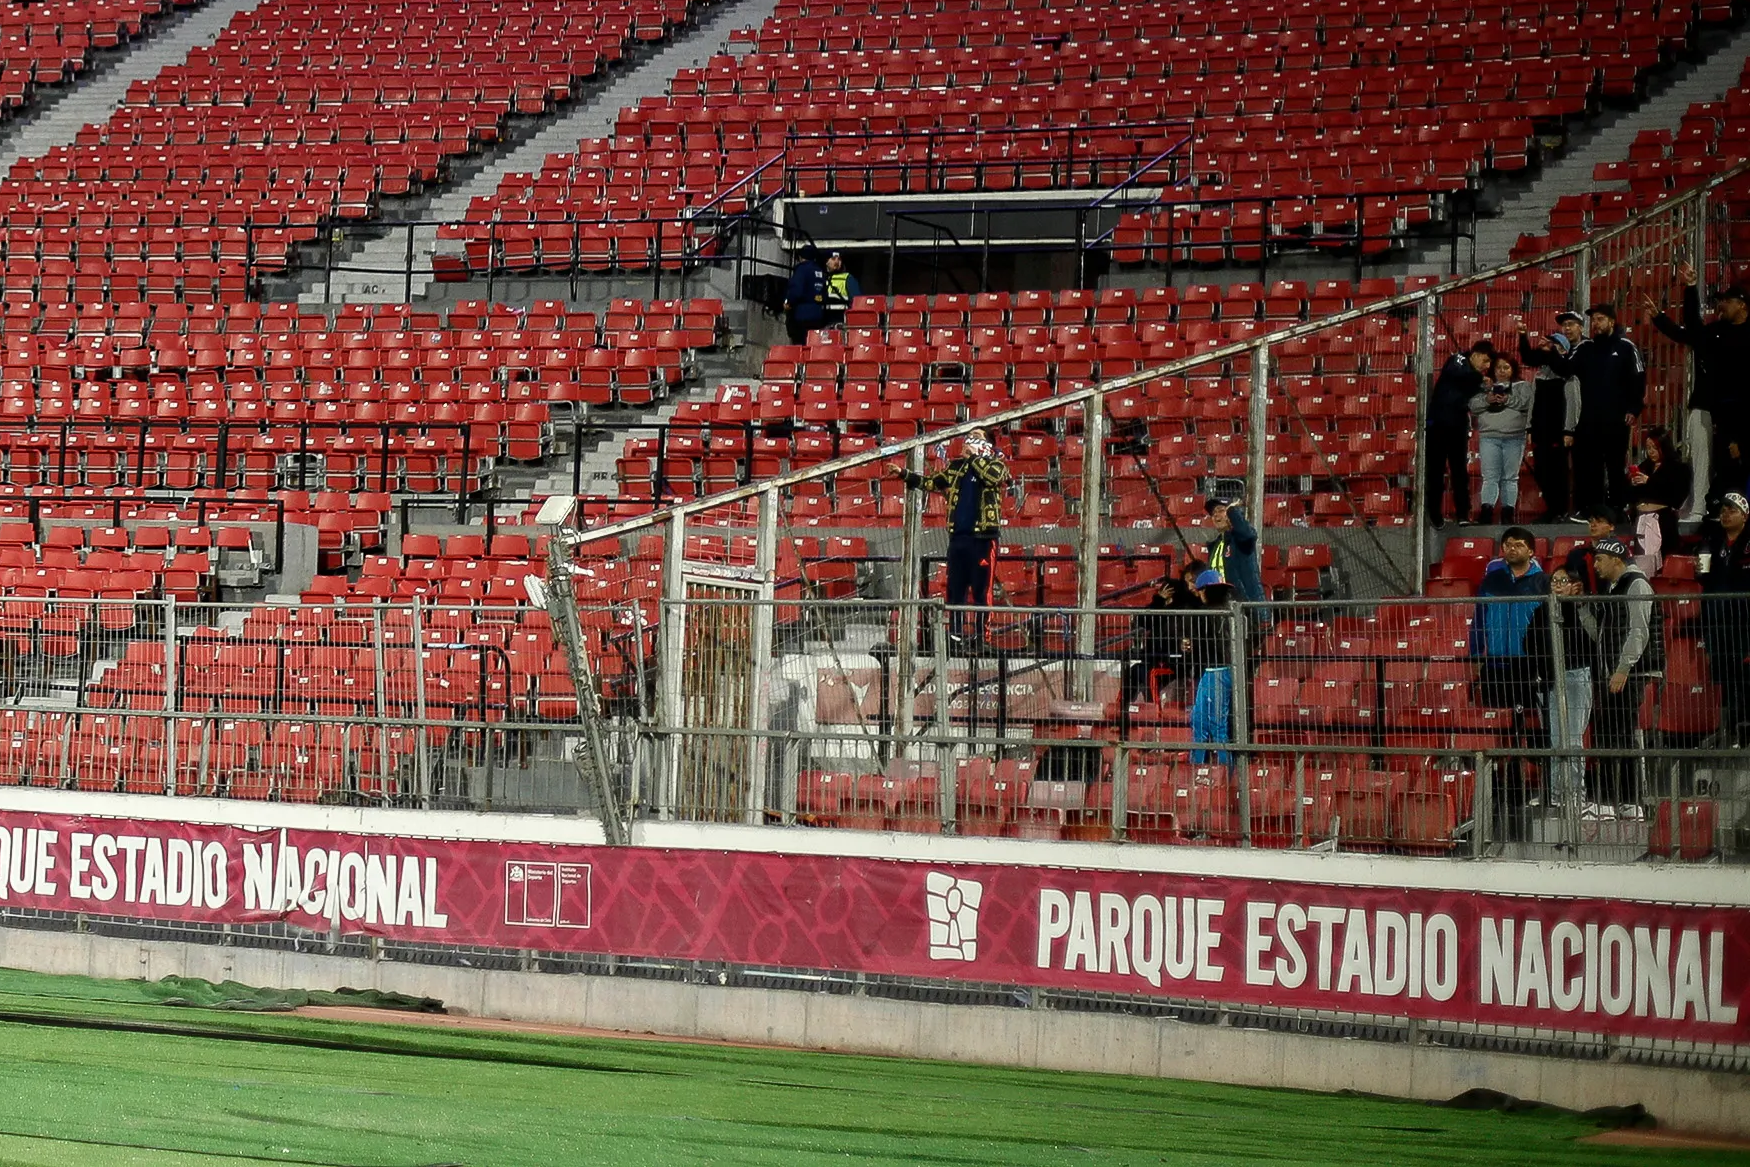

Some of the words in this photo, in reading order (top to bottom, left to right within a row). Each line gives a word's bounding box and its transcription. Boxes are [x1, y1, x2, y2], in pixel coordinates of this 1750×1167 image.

[69, 832, 230, 910] ESTADIO
[242, 841, 449, 929] NACIONAL
[1036, 889, 1225, 987] PARQUE
[1245, 901, 1459, 1002] ESTADIO
[1479, 916, 1740, 1025] NACIONAL
